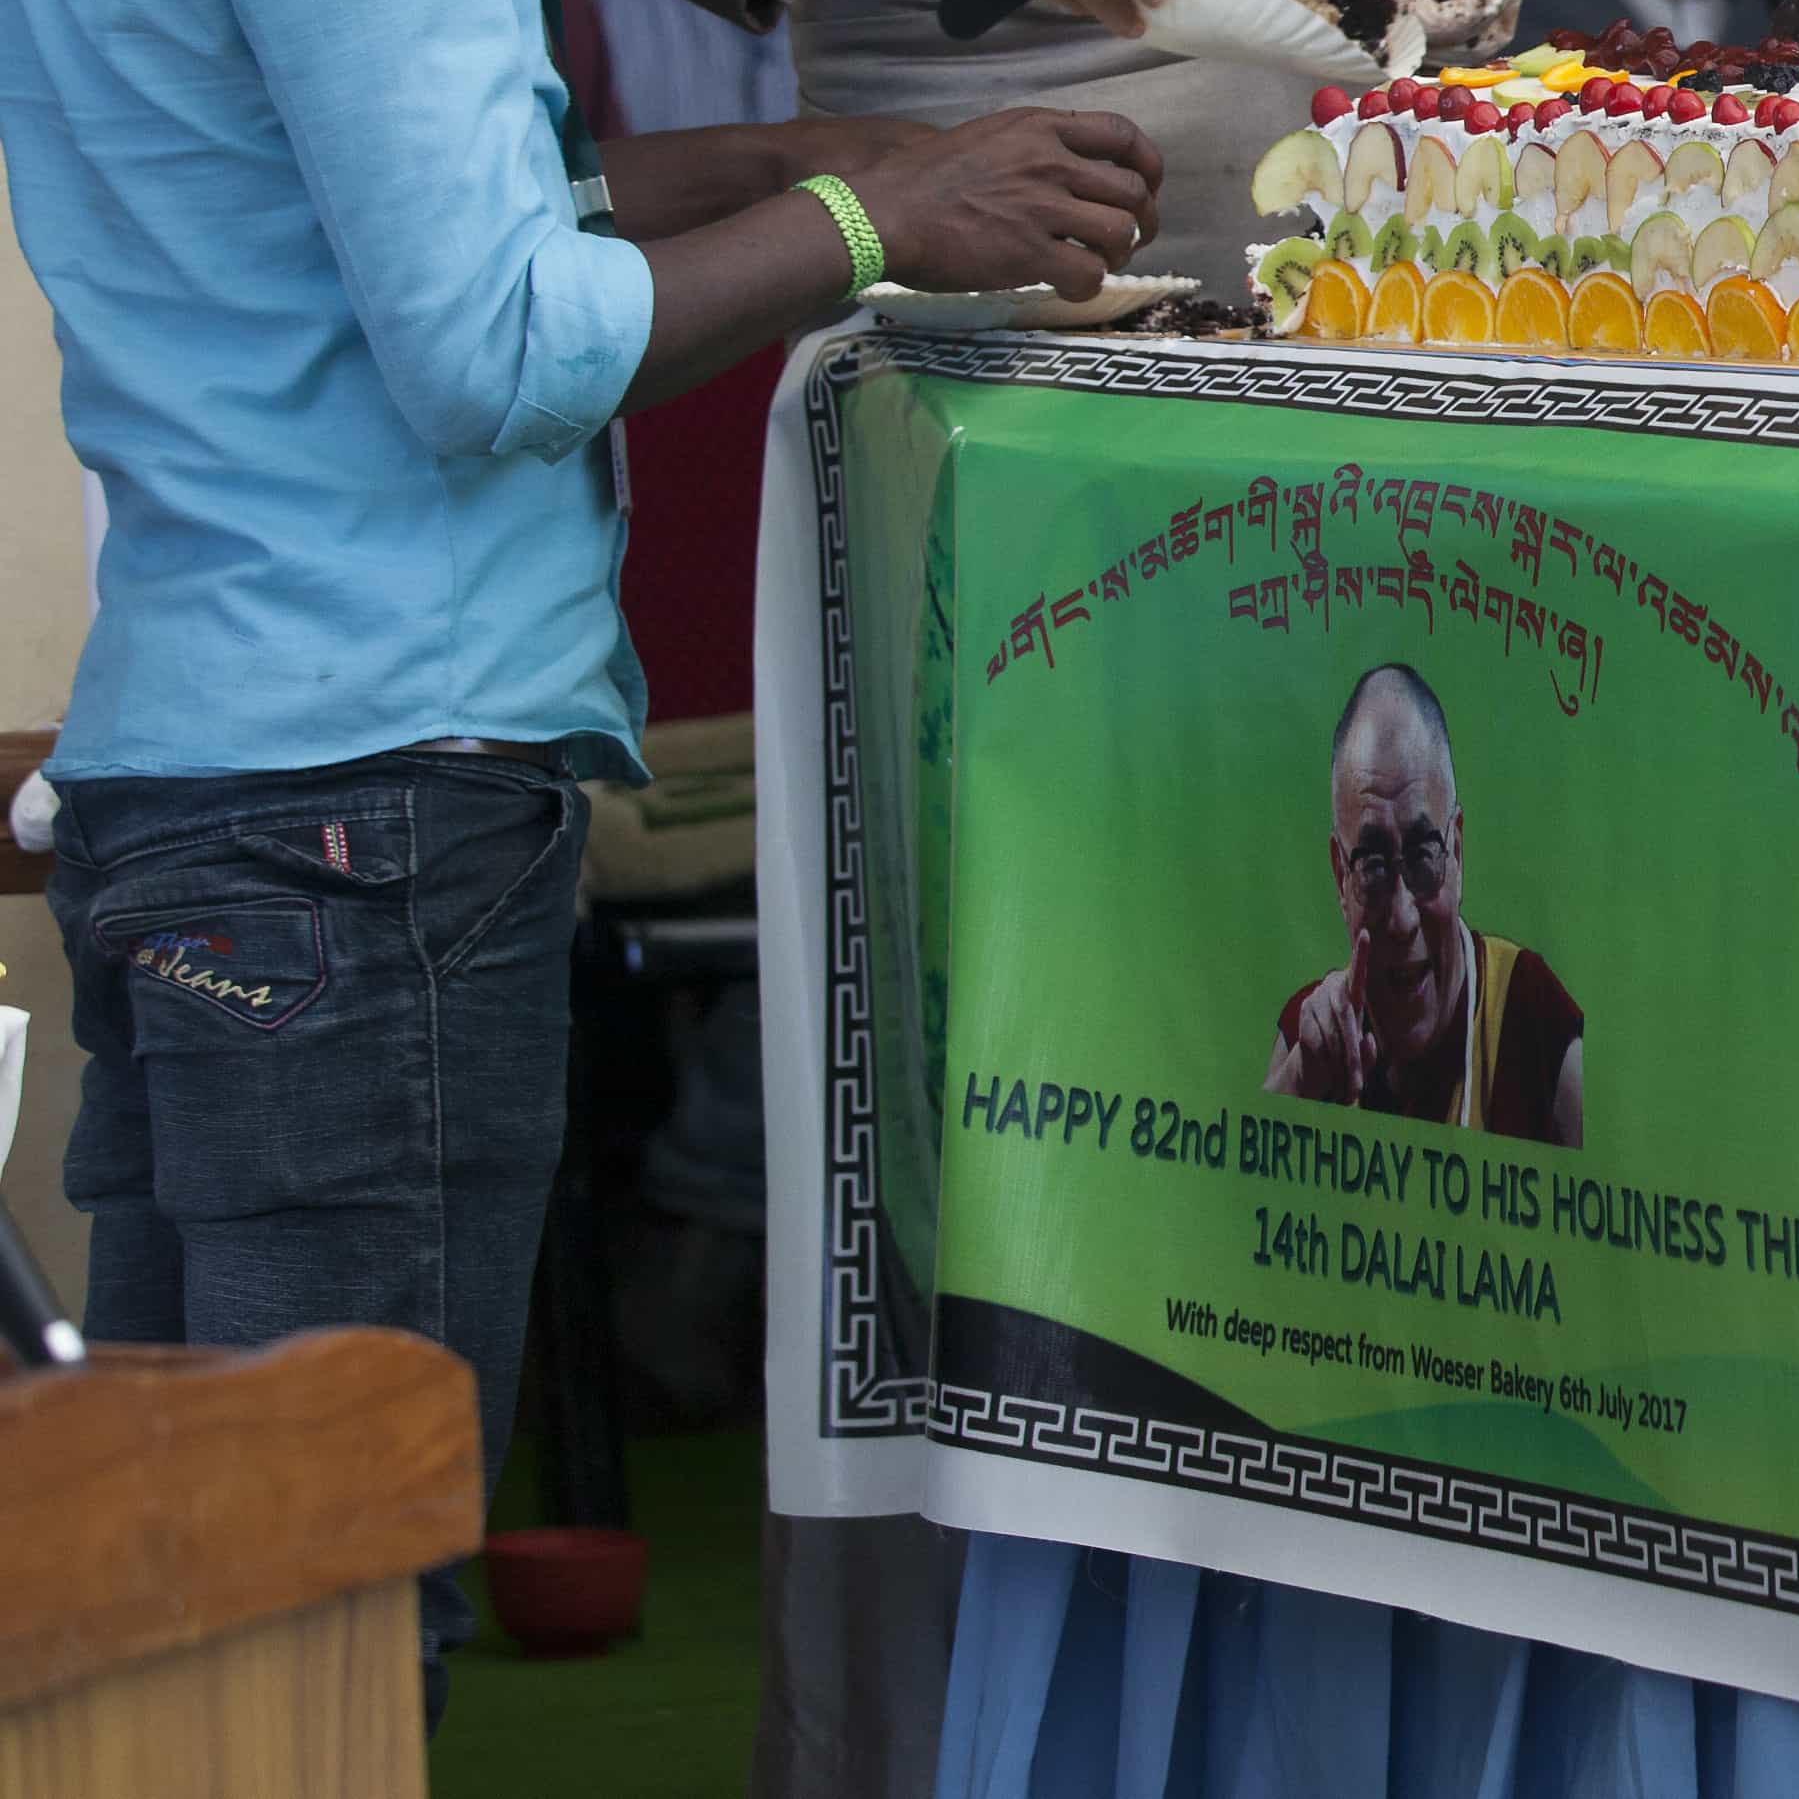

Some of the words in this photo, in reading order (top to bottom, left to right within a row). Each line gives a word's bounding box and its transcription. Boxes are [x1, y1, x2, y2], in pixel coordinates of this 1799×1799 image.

[962, 1072, 1122, 1150] HAPPY
[1131, 1097, 1229, 1169] 82nd
[1239, 1114, 1413, 1201] BIRTHDAY
[1423, 1148, 1470, 1214] TO
[1482, 1159, 1541, 1229] HIS
[1552, 1173, 1727, 1266] HOLINESS
[1253, 1206, 1329, 1278] 14th
[1341, 1222, 1447, 1301] DALAI
[1456, 1244, 1562, 1325] LAMA
[1166, 1298, 1217, 1338] With
[1224, 1308, 1276, 1356] deep
[1281, 1325, 1353, 1367] respect
[1358, 1333, 1405, 1376] from
[1411, 1343, 1484, 1391] Woeser
[1490, 1359, 1554, 1414] Bakery
[1559, 1375, 1592, 1416] 6th
[1596, 1384, 1633, 1431] July
[1638, 1393, 1688, 1434] 2017
